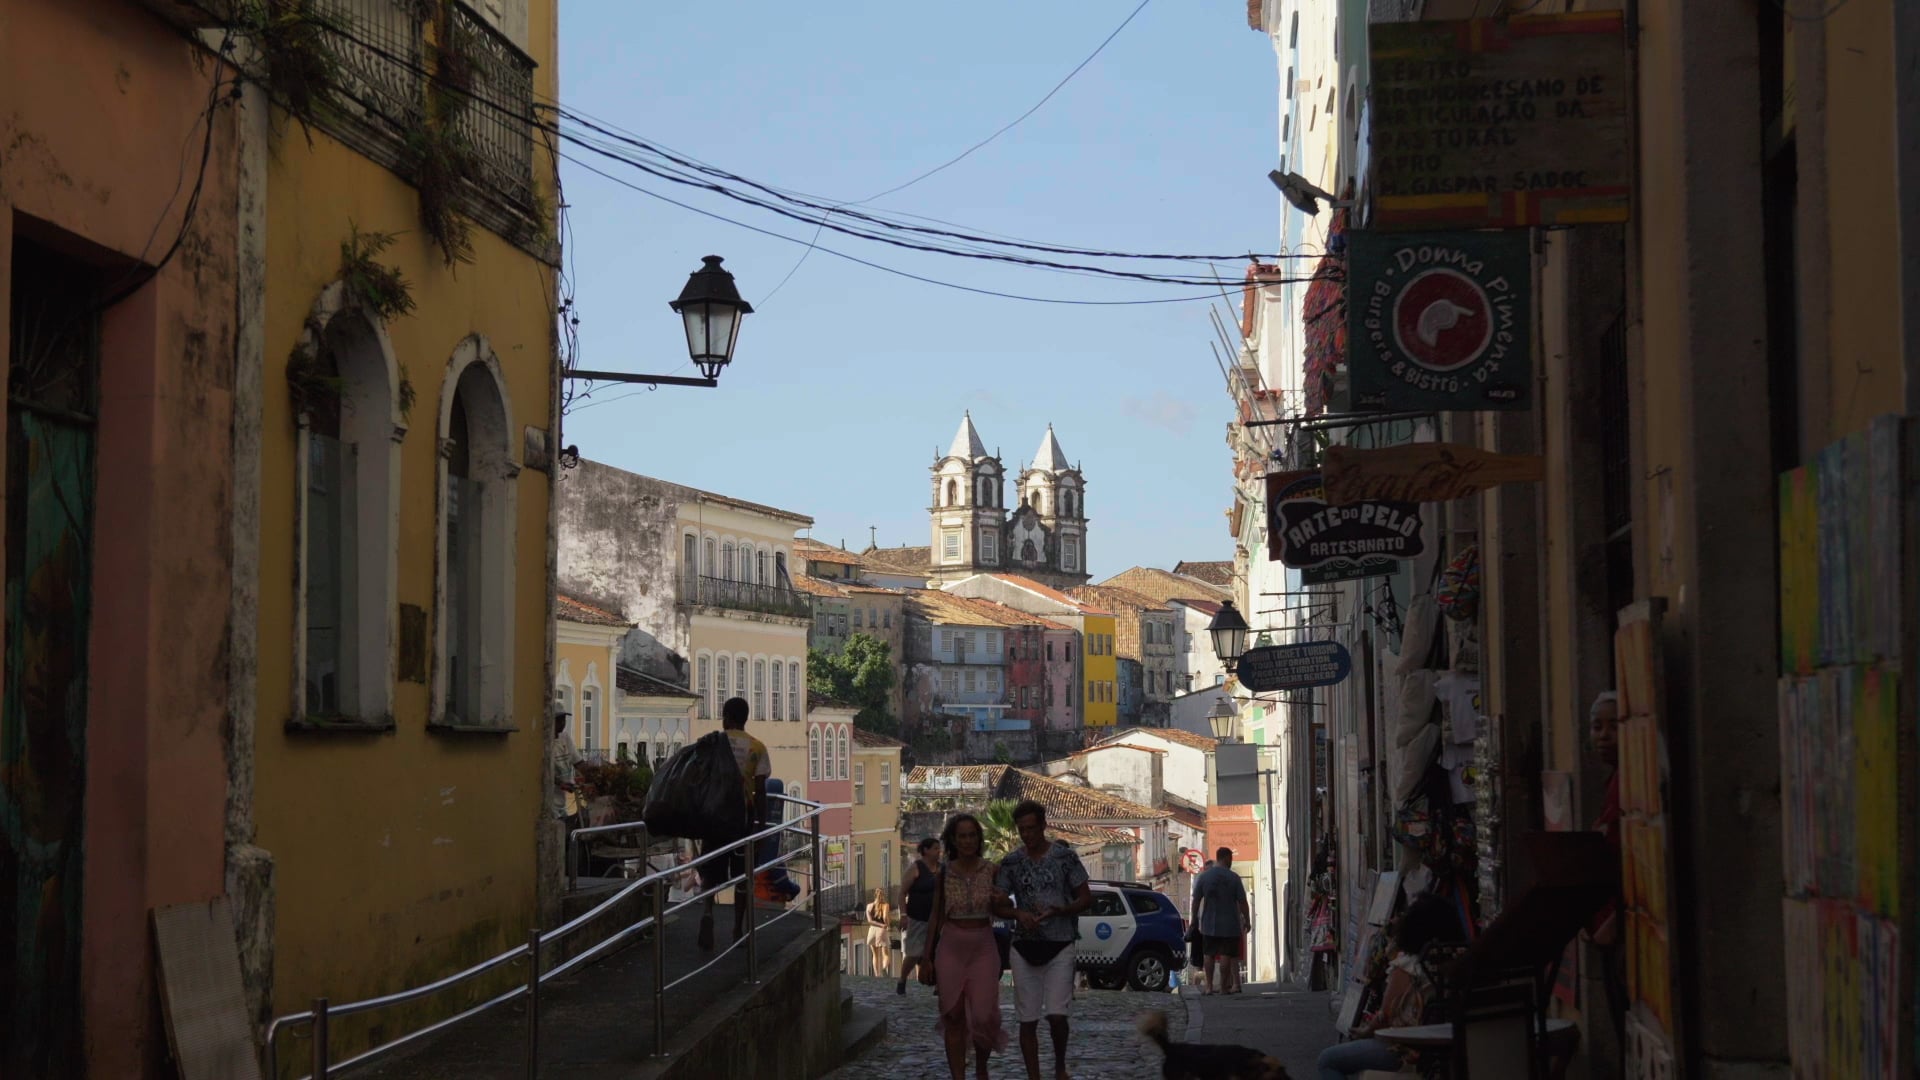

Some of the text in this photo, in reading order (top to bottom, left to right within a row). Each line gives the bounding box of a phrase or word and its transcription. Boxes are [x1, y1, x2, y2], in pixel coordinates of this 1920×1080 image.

[1575, 75, 1603, 95] DE
[1555, 100, 1586, 119] DA
[1512, 171, 1587, 191] SADOC
[1393, 246, 1517, 383] Donna Pimenta
[1365, 280, 1391, 362] Burgers
[1391, 361, 1406, 376] &
[1288, 506, 1342, 549] ARTE
[1341, 508, 1359, 520] DO
[1310, 537, 1405, 556] ARTESANATO
[1270, 647, 1301, 660] TICKET
[1302, 643, 1338, 658] TURISMO
[1275, 655, 1330, 668] INFORMATION
